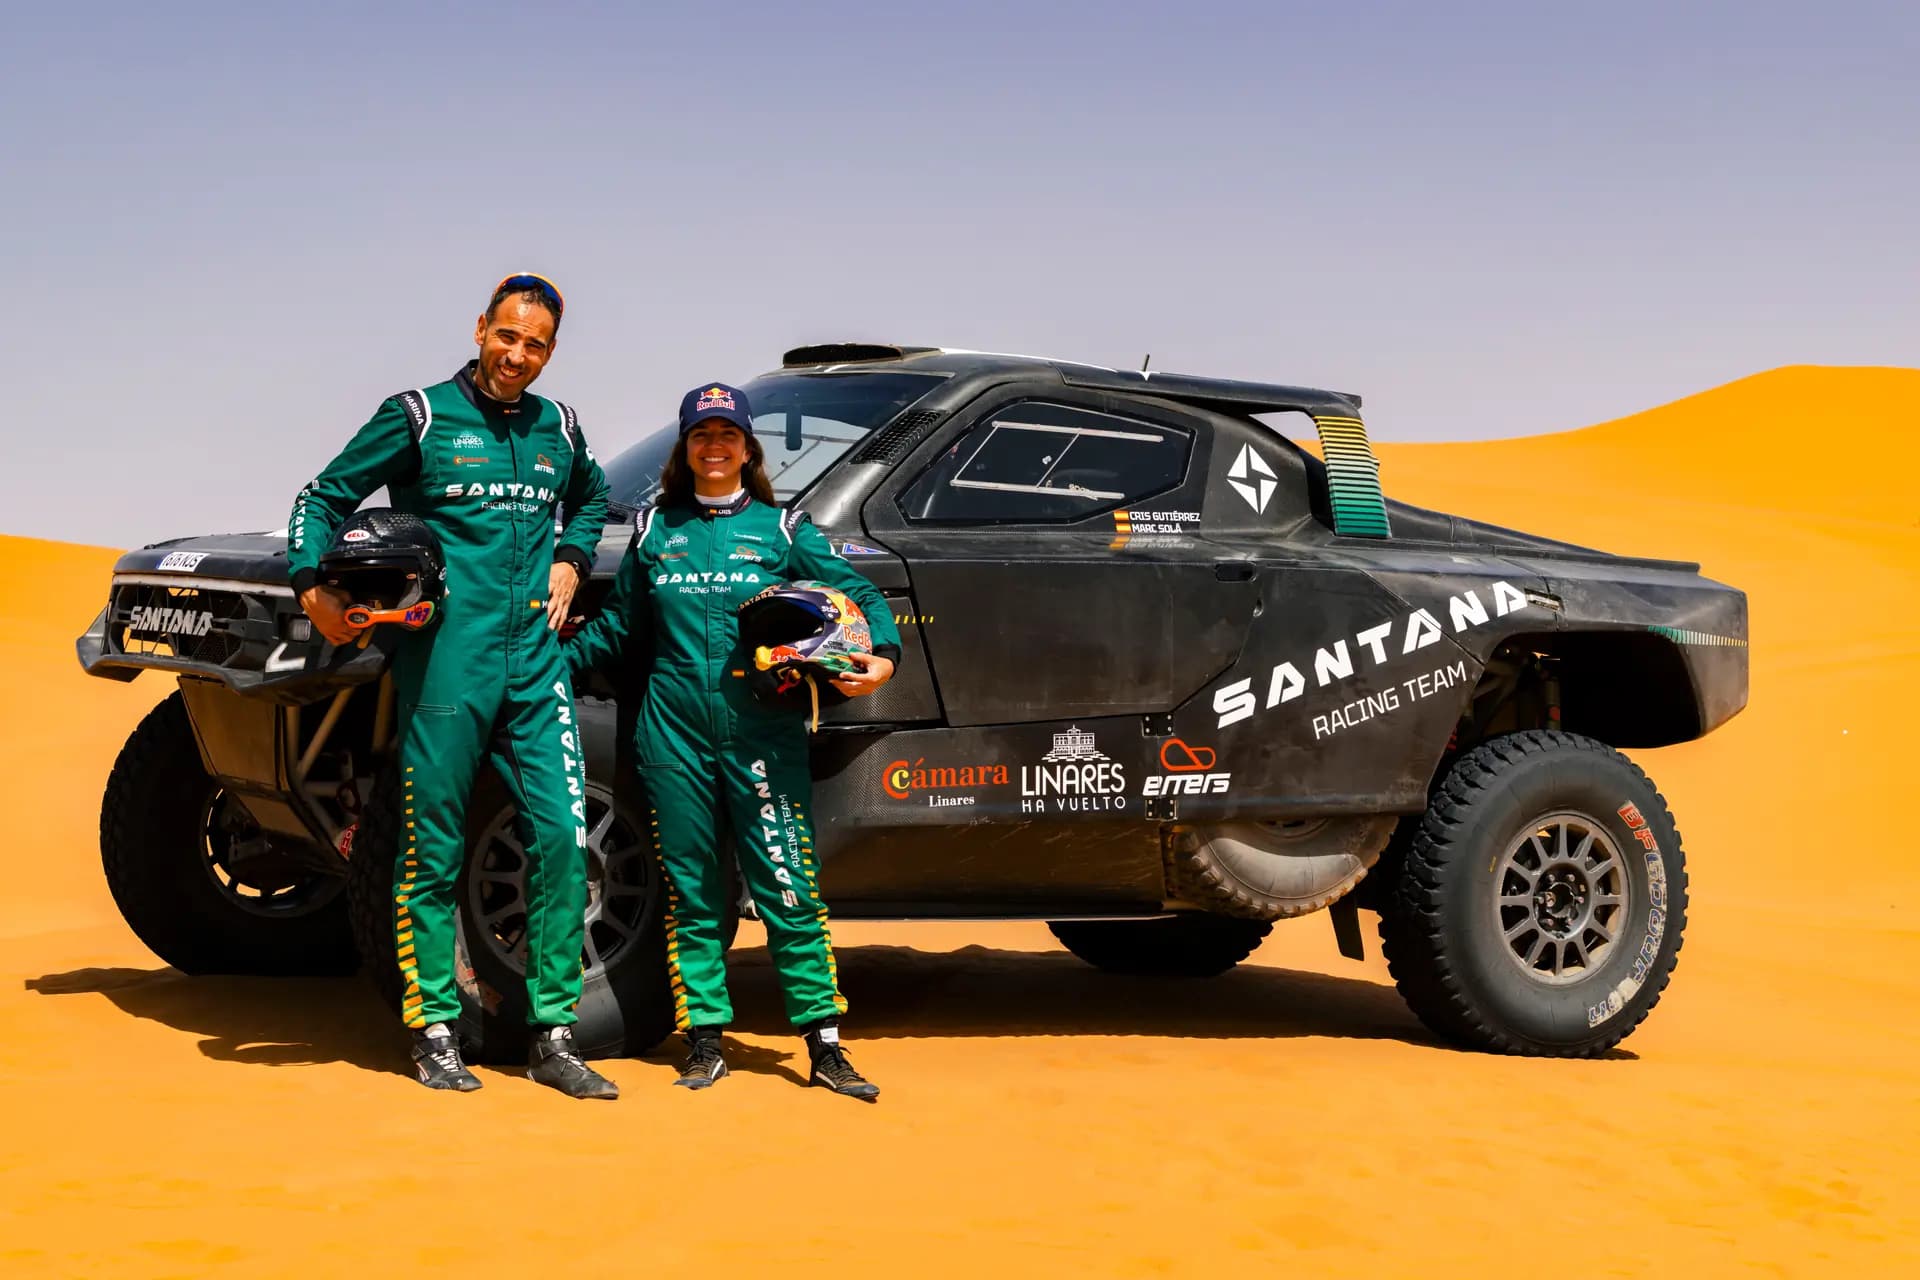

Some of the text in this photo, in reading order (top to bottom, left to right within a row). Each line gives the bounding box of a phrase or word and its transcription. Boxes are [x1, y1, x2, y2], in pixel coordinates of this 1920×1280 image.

[518, 503, 539, 513] TEAM
[1129, 510, 1201, 522] CRIS GUTIÉRREZ
[1131, 523, 1158, 533] MARC
[655, 572, 761, 585] SANTANA
[679, 585, 732, 594] RACING TEAM
[129, 605, 214, 637] SANTANA
[1212, 578, 1529, 730] SANTANA
[1312, 659, 1468, 741] RACING TEAM
[552, 680, 588, 849] SANTANA
[1021, 763, 1127, 797] LINARES
[928, 793, 976, 808] Linares
[1021, 795, 1127, 814] HA VUELTO
[750, 758, 800, 909] SANTANA
[778, 793, 801, 869] RACING TEAM
